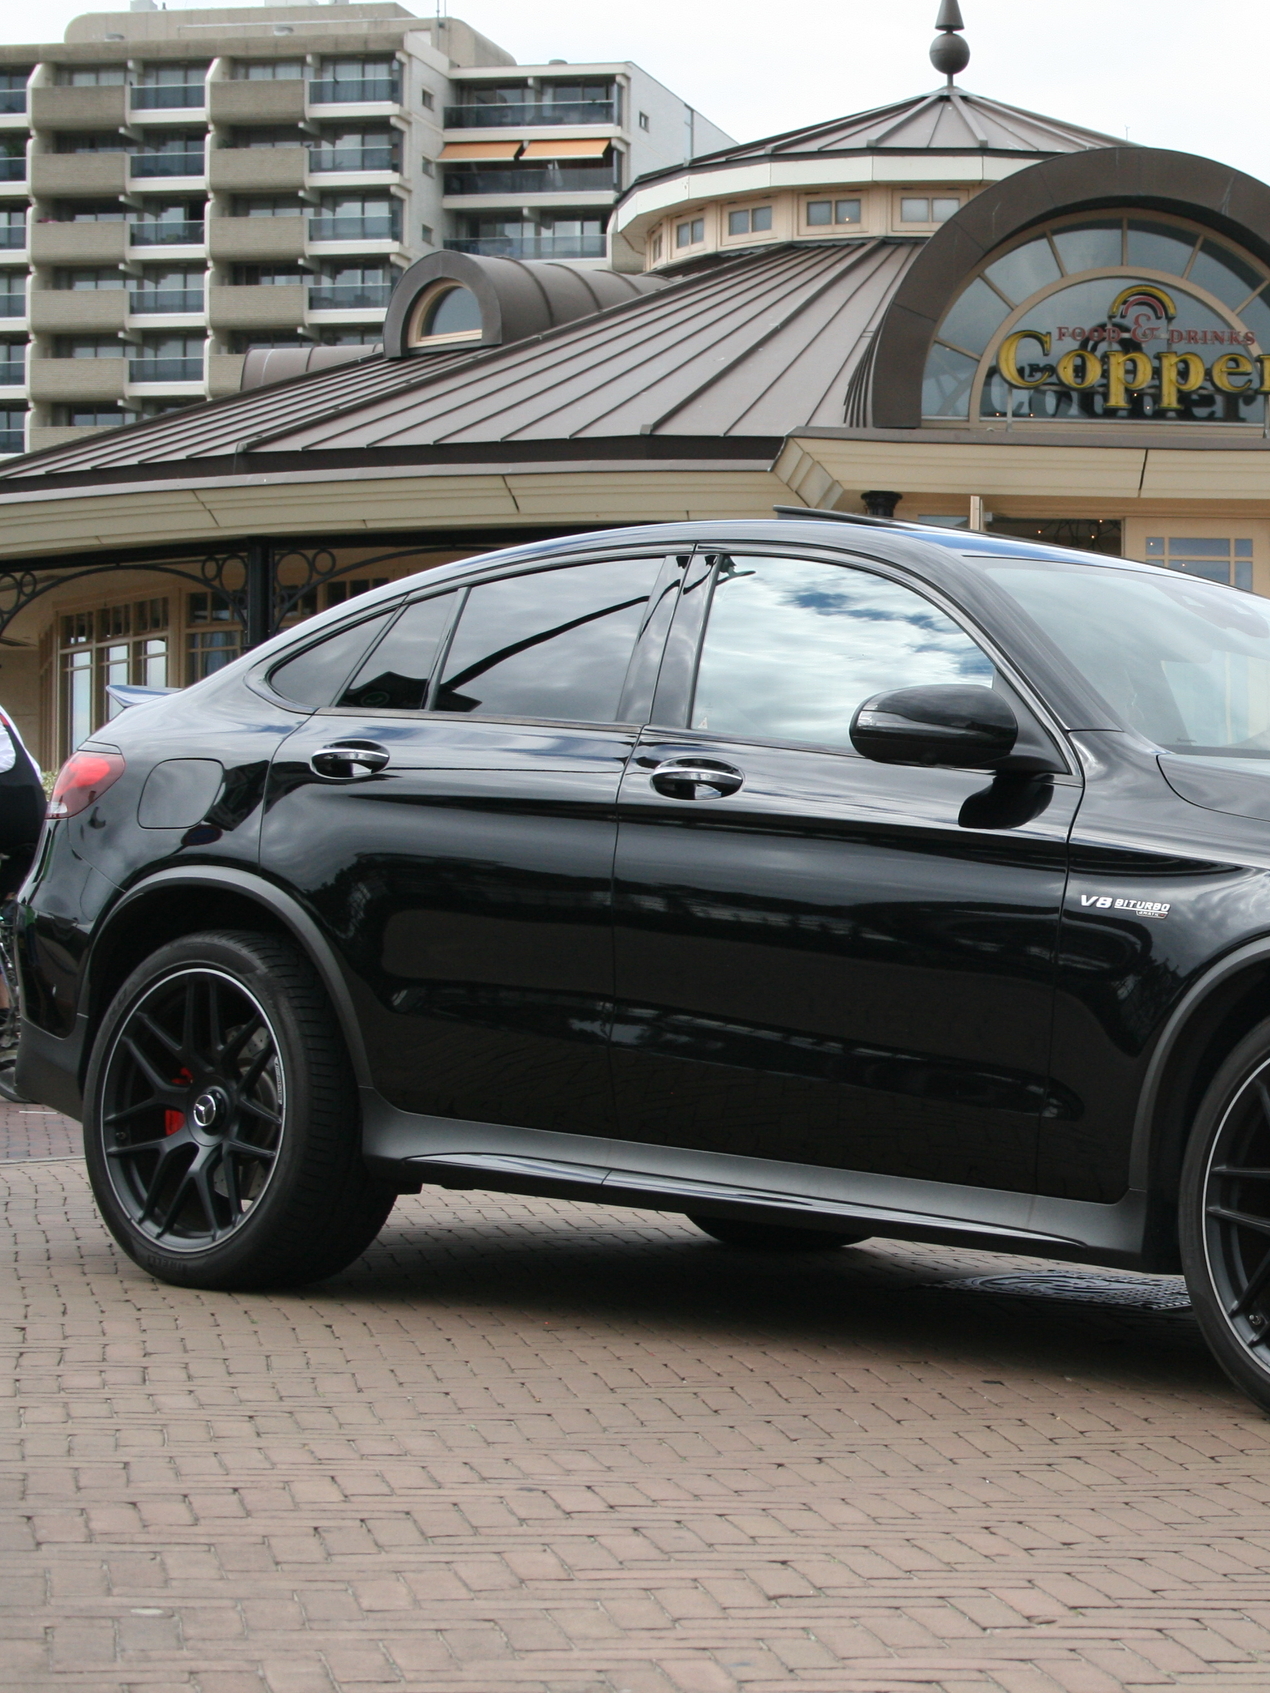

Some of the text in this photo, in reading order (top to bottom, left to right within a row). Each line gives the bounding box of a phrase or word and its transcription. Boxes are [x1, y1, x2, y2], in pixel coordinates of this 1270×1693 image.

[1056, 313, 1257, 346] FOOD & DRINKS
[1080, 894, 1171, 912] V8 BITURBO
